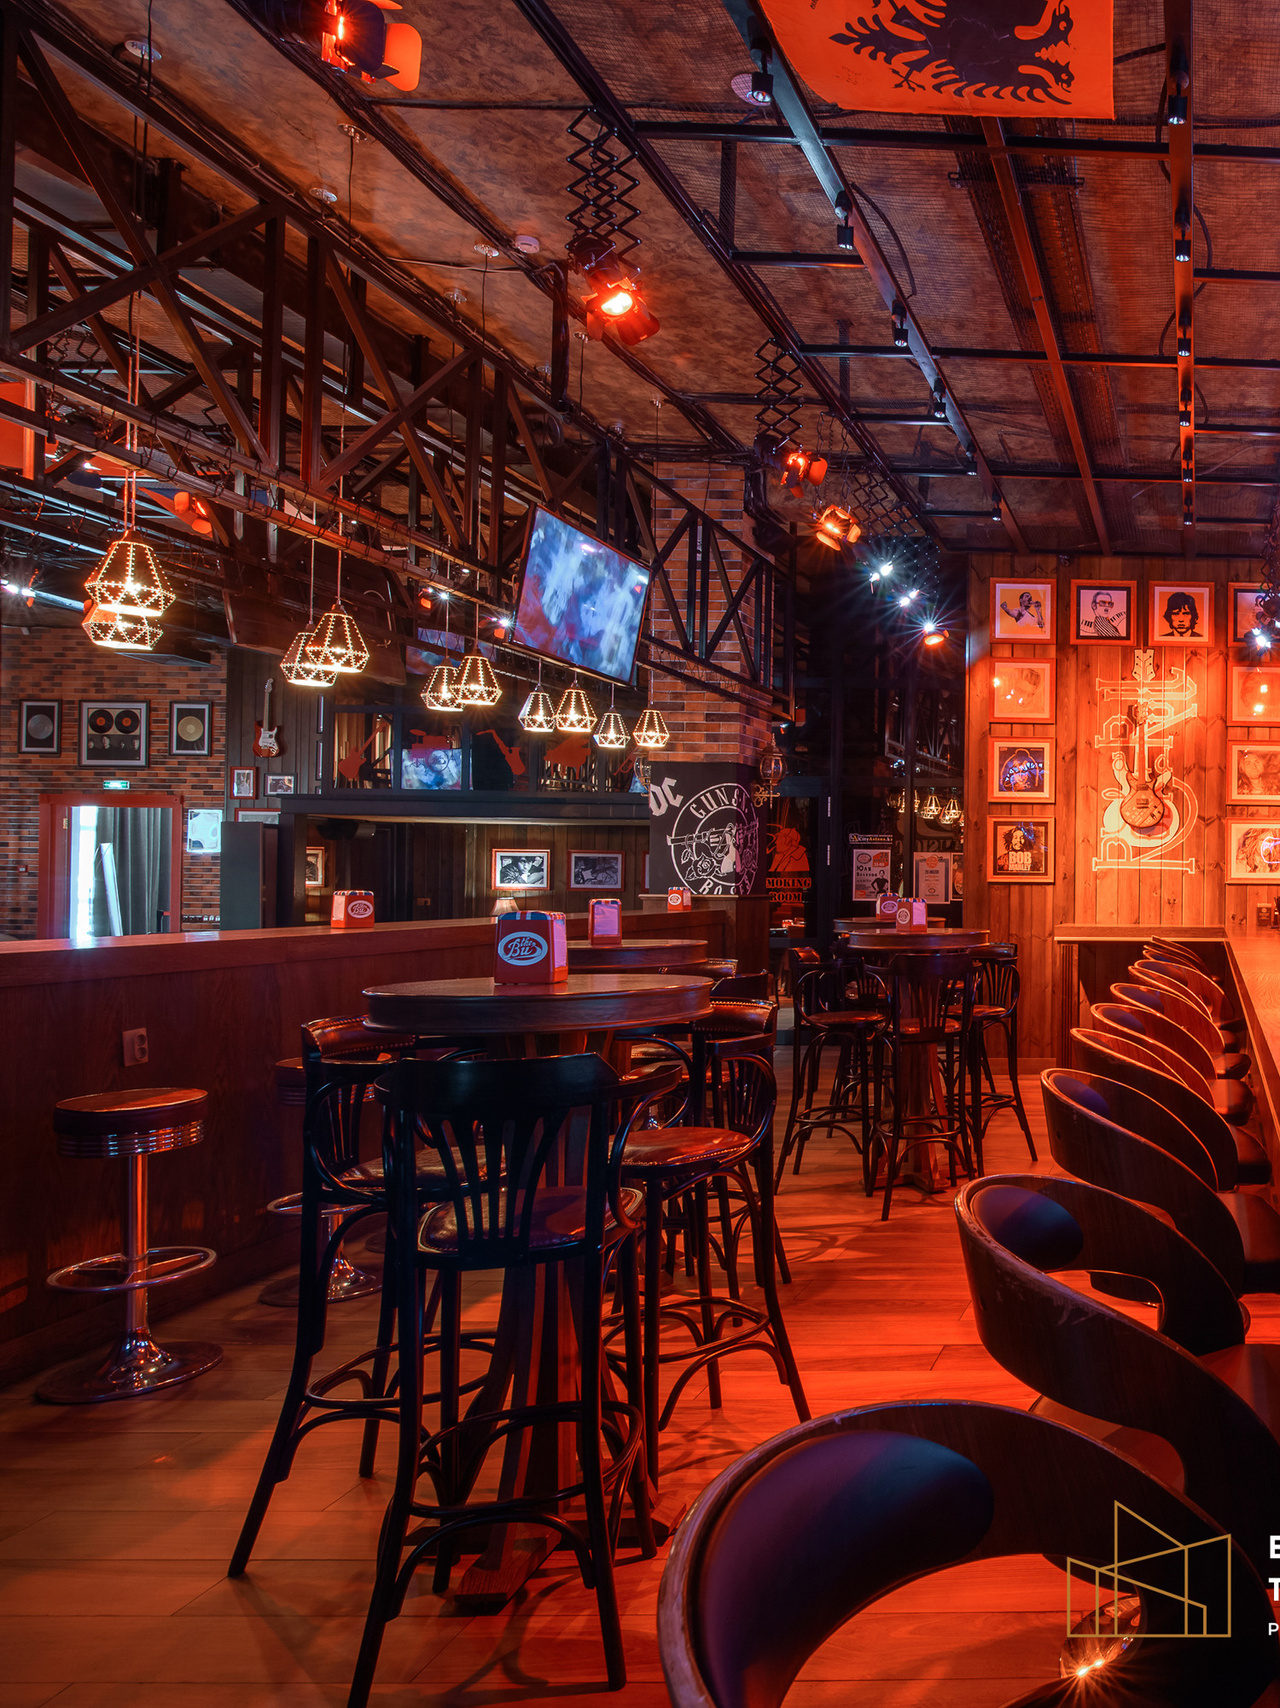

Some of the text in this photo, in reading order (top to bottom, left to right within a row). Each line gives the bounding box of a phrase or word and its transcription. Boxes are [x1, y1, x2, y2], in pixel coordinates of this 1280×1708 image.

[650, 777, 684, 817] DC
[689, 787, 739, 819] GUNS
[1008, 852, 1032, 864] BOB
[766, 878, 812, 888] MOKING
